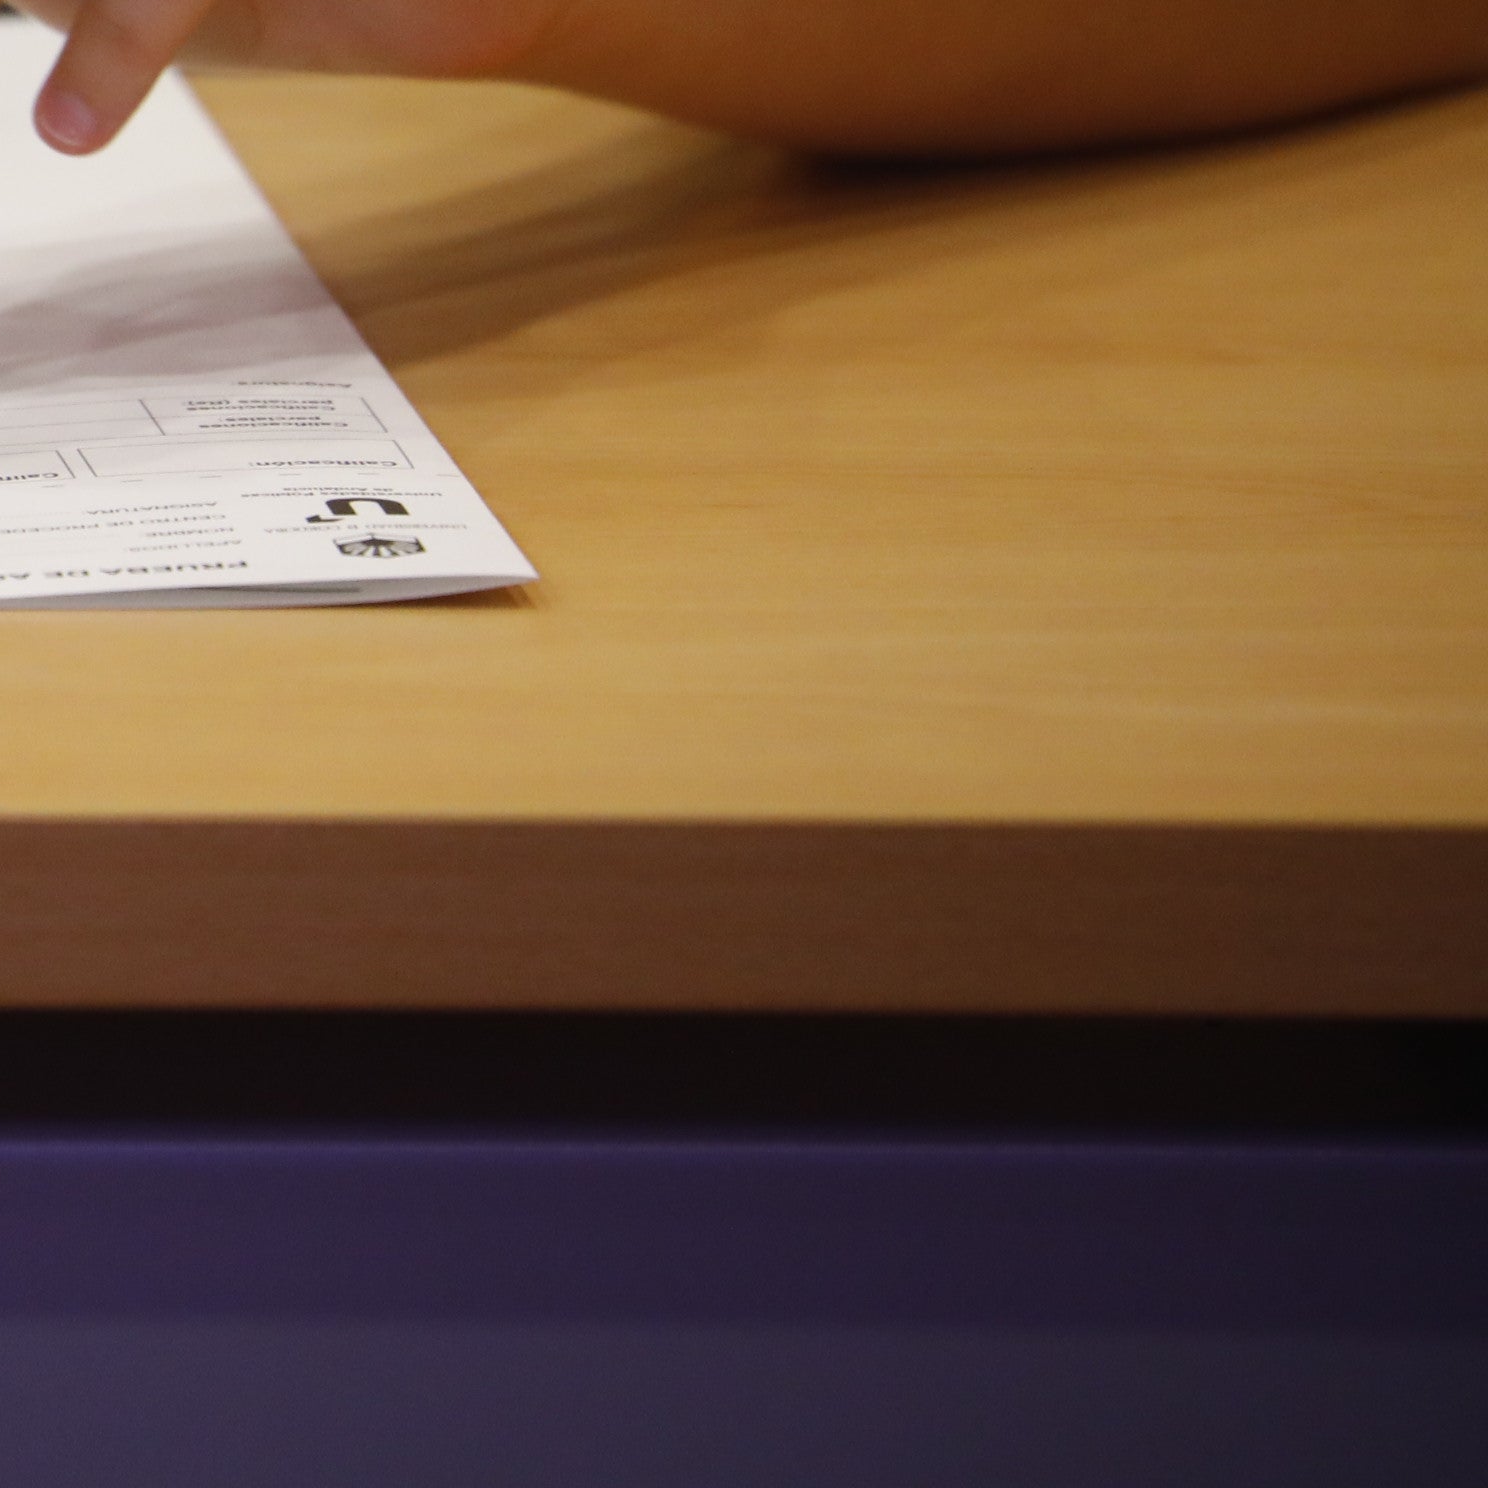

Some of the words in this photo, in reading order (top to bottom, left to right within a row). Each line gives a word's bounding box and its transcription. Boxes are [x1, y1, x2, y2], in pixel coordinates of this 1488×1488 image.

[197, 420, 347, 428] Calificaciones
[106, 519, 133, 527] DE
[138, 513, 225, 524] CENTRO
[99, 560, 247, 575] PRUEBA
[43, 569, 88, 578] DE
